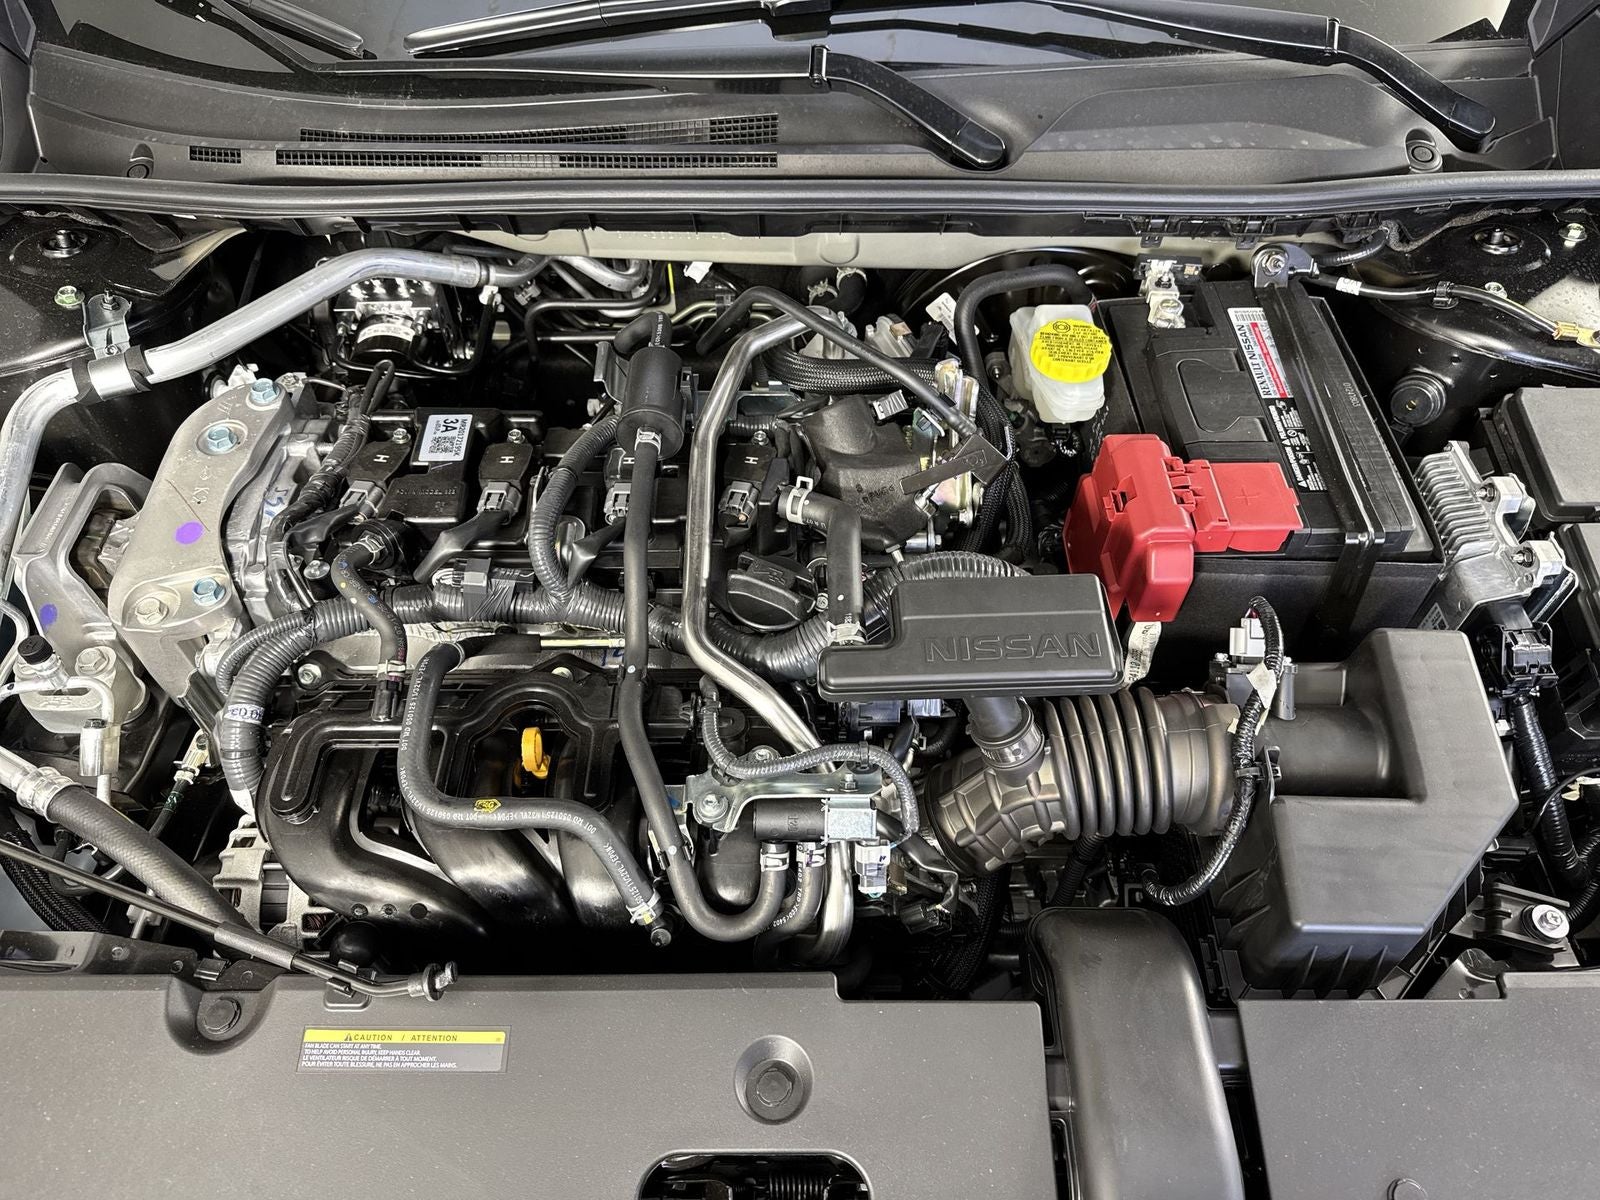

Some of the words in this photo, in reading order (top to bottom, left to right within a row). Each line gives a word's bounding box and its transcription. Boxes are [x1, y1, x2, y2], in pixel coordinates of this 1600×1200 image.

[1236, 323, 1257, 360] NISSAN
[1250, 362, 1272, 396] RENAULT
[441, 419, 459, 433] 3A
[925, 632, 1102, 662] NISSAN
